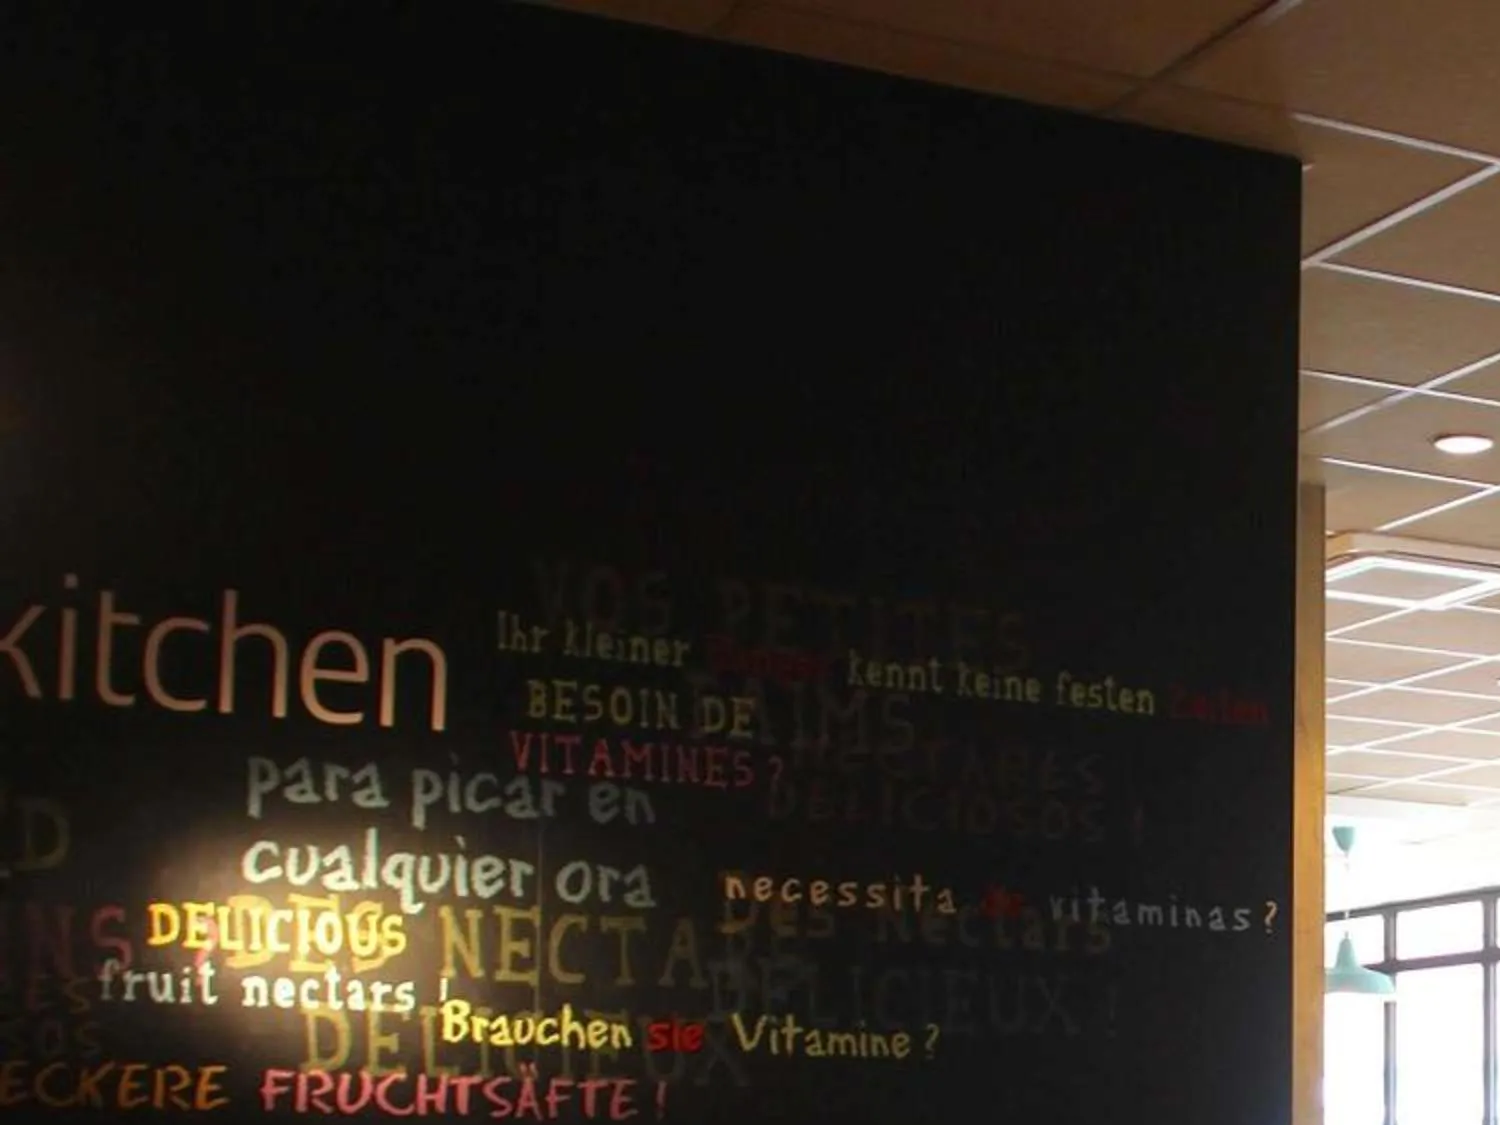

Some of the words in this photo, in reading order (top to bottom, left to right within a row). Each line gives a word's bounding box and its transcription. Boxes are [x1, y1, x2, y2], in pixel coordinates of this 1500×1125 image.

[495, 610, 549, 653] Ihr
[563, 618, 689, 668] kleiner
[847, 646, 943, 693] kennt
[956, 660, 1042, 703] keine
[1056, 671, 1155, 716] festen
[525, 677, 682, 731] BESOIN
[699, 694, 756, 740] DE
[508, 730, 756, 788] VITAMINES
[246, 756, 390, 819] para
[411, 753, 564, 828] picar
[588, 780, 656, 824] en
[241, 828, 534, 913] cualquier
[555, 860, 656, 908] ora
[147, 902, 407, 956] DELICIOUS
[723, 872, 957, 914] necessita
[1049, 884, 1251, 932] vitaminas
[98, 958, 218, 1005] fruit
[241, 961, 415, 1012] nectars
[441, 998, 634, 1049] Brauchen
[647, 1014, 704, 1053] sie
[731, 1012, 911, 1058] Vitamine
[260, 1061, 638, 1120] FRUCHTSÄFTE
